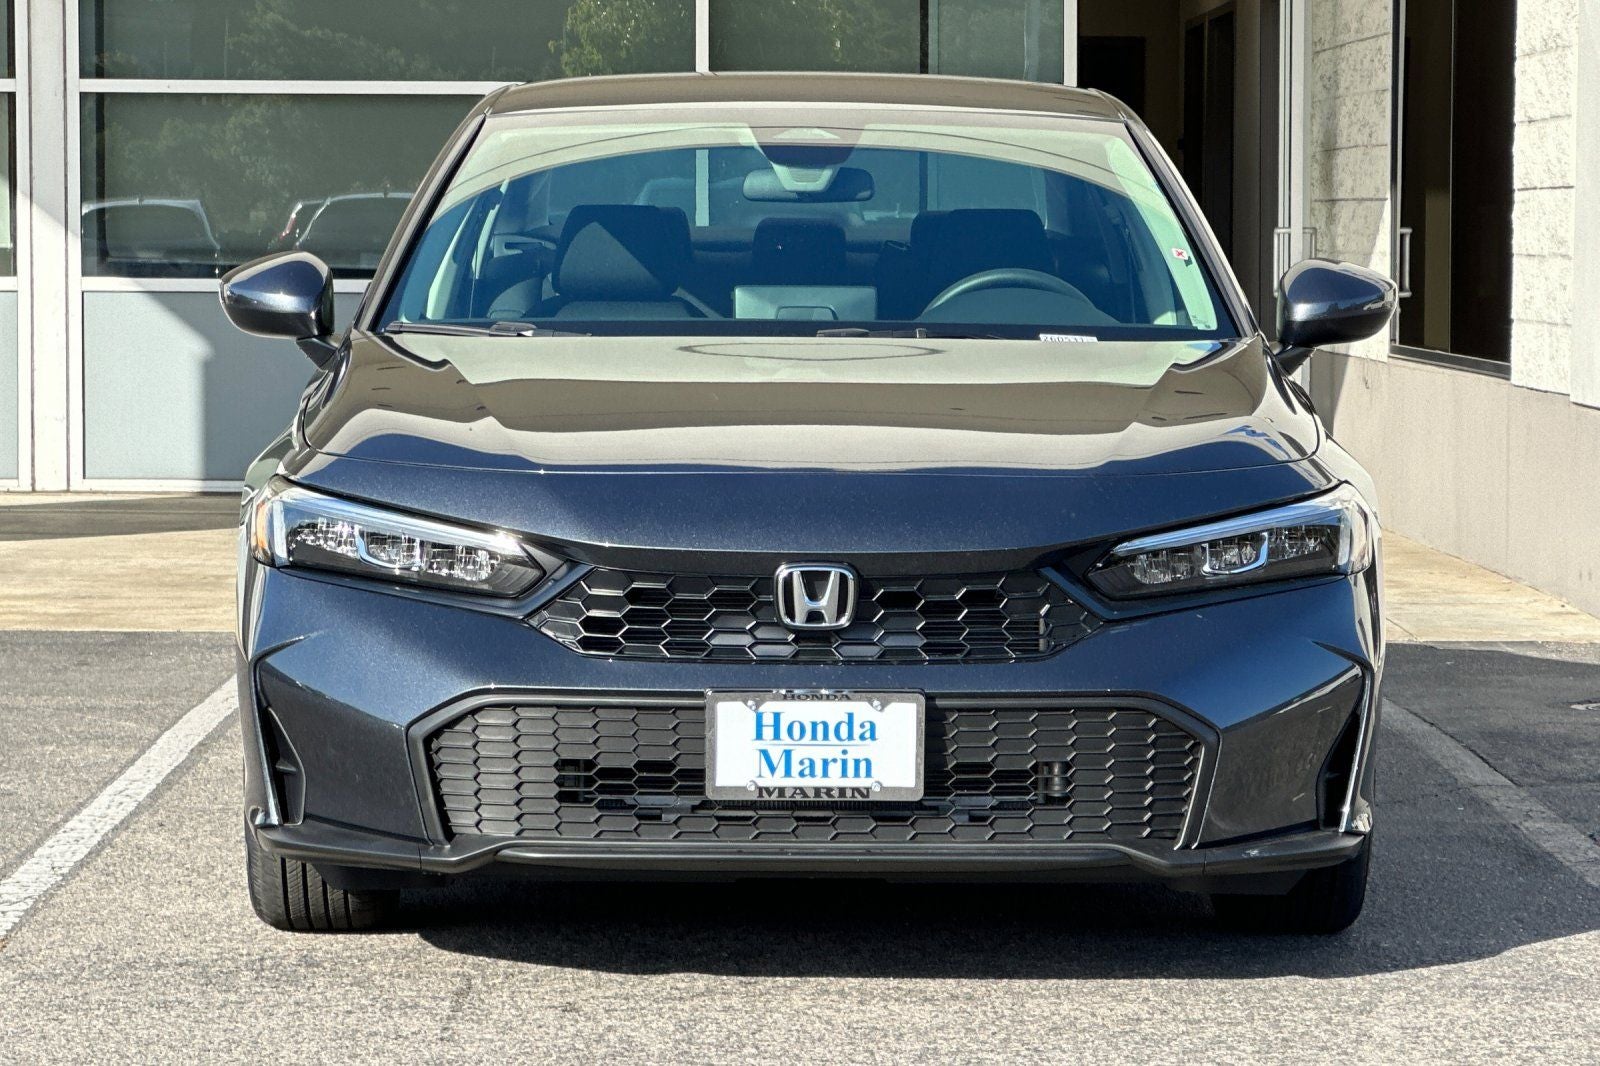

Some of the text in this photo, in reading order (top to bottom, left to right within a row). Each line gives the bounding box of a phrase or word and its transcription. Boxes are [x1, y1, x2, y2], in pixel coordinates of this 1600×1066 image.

[781, 693, 853, 701] HONDA
[752, 711, 878, 742] Honda
[756, 748, 873, 779] Marin
[757, 786, 871, 799] MARIN
